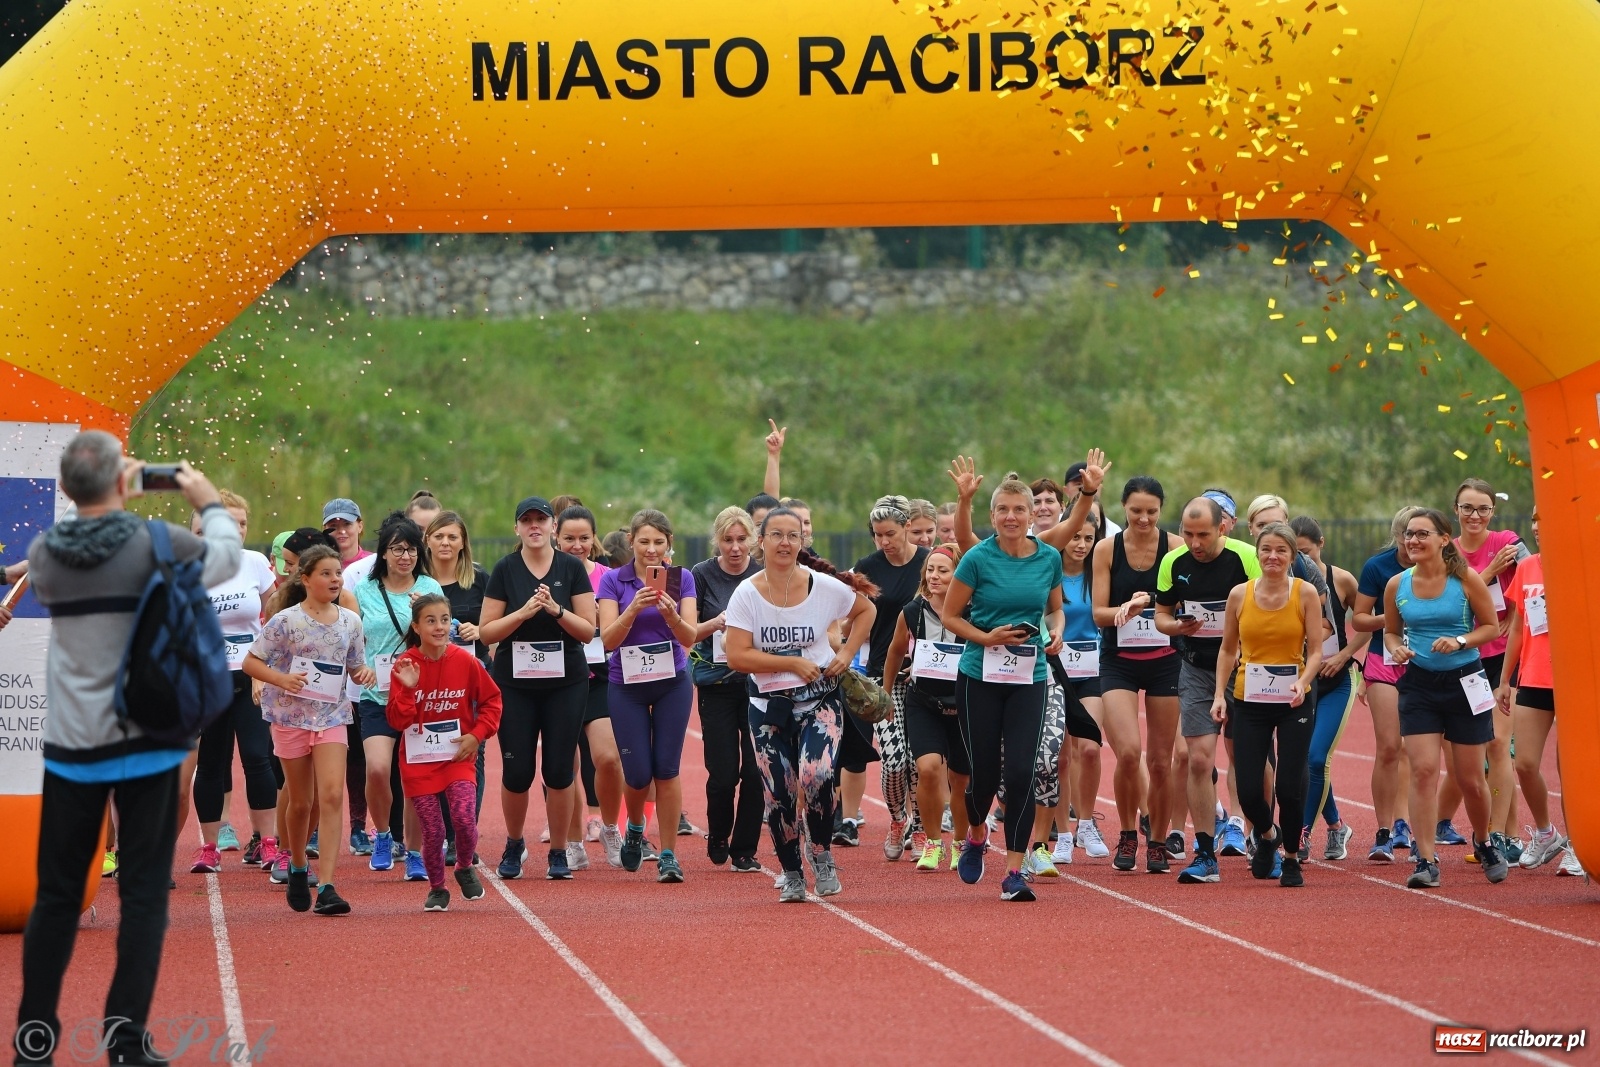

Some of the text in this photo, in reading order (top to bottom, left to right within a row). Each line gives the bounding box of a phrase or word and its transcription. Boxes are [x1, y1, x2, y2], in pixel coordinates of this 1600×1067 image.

[471, 36, 770, 102] MIASTO
[1202, 612, 1218, 623] 31
[1136, 620, 1151, 631] 11
[760, 626, 815, 643] KOBIETA
[225, 645, 239, 655] 25
[530, 652, 546, 663] 38
[640, 654, 656, 666] 15
[931, 652, 947, 663] 37
[1003, 655, 1018, 667] 24
[1067, 651, 1082, 662] 19
[312, 672, 322, 684] 2
[1268, 675, 1276, 687] 7
[423, 700, 459, 713] Bejbe
[425, 733, 441, 745] 41
